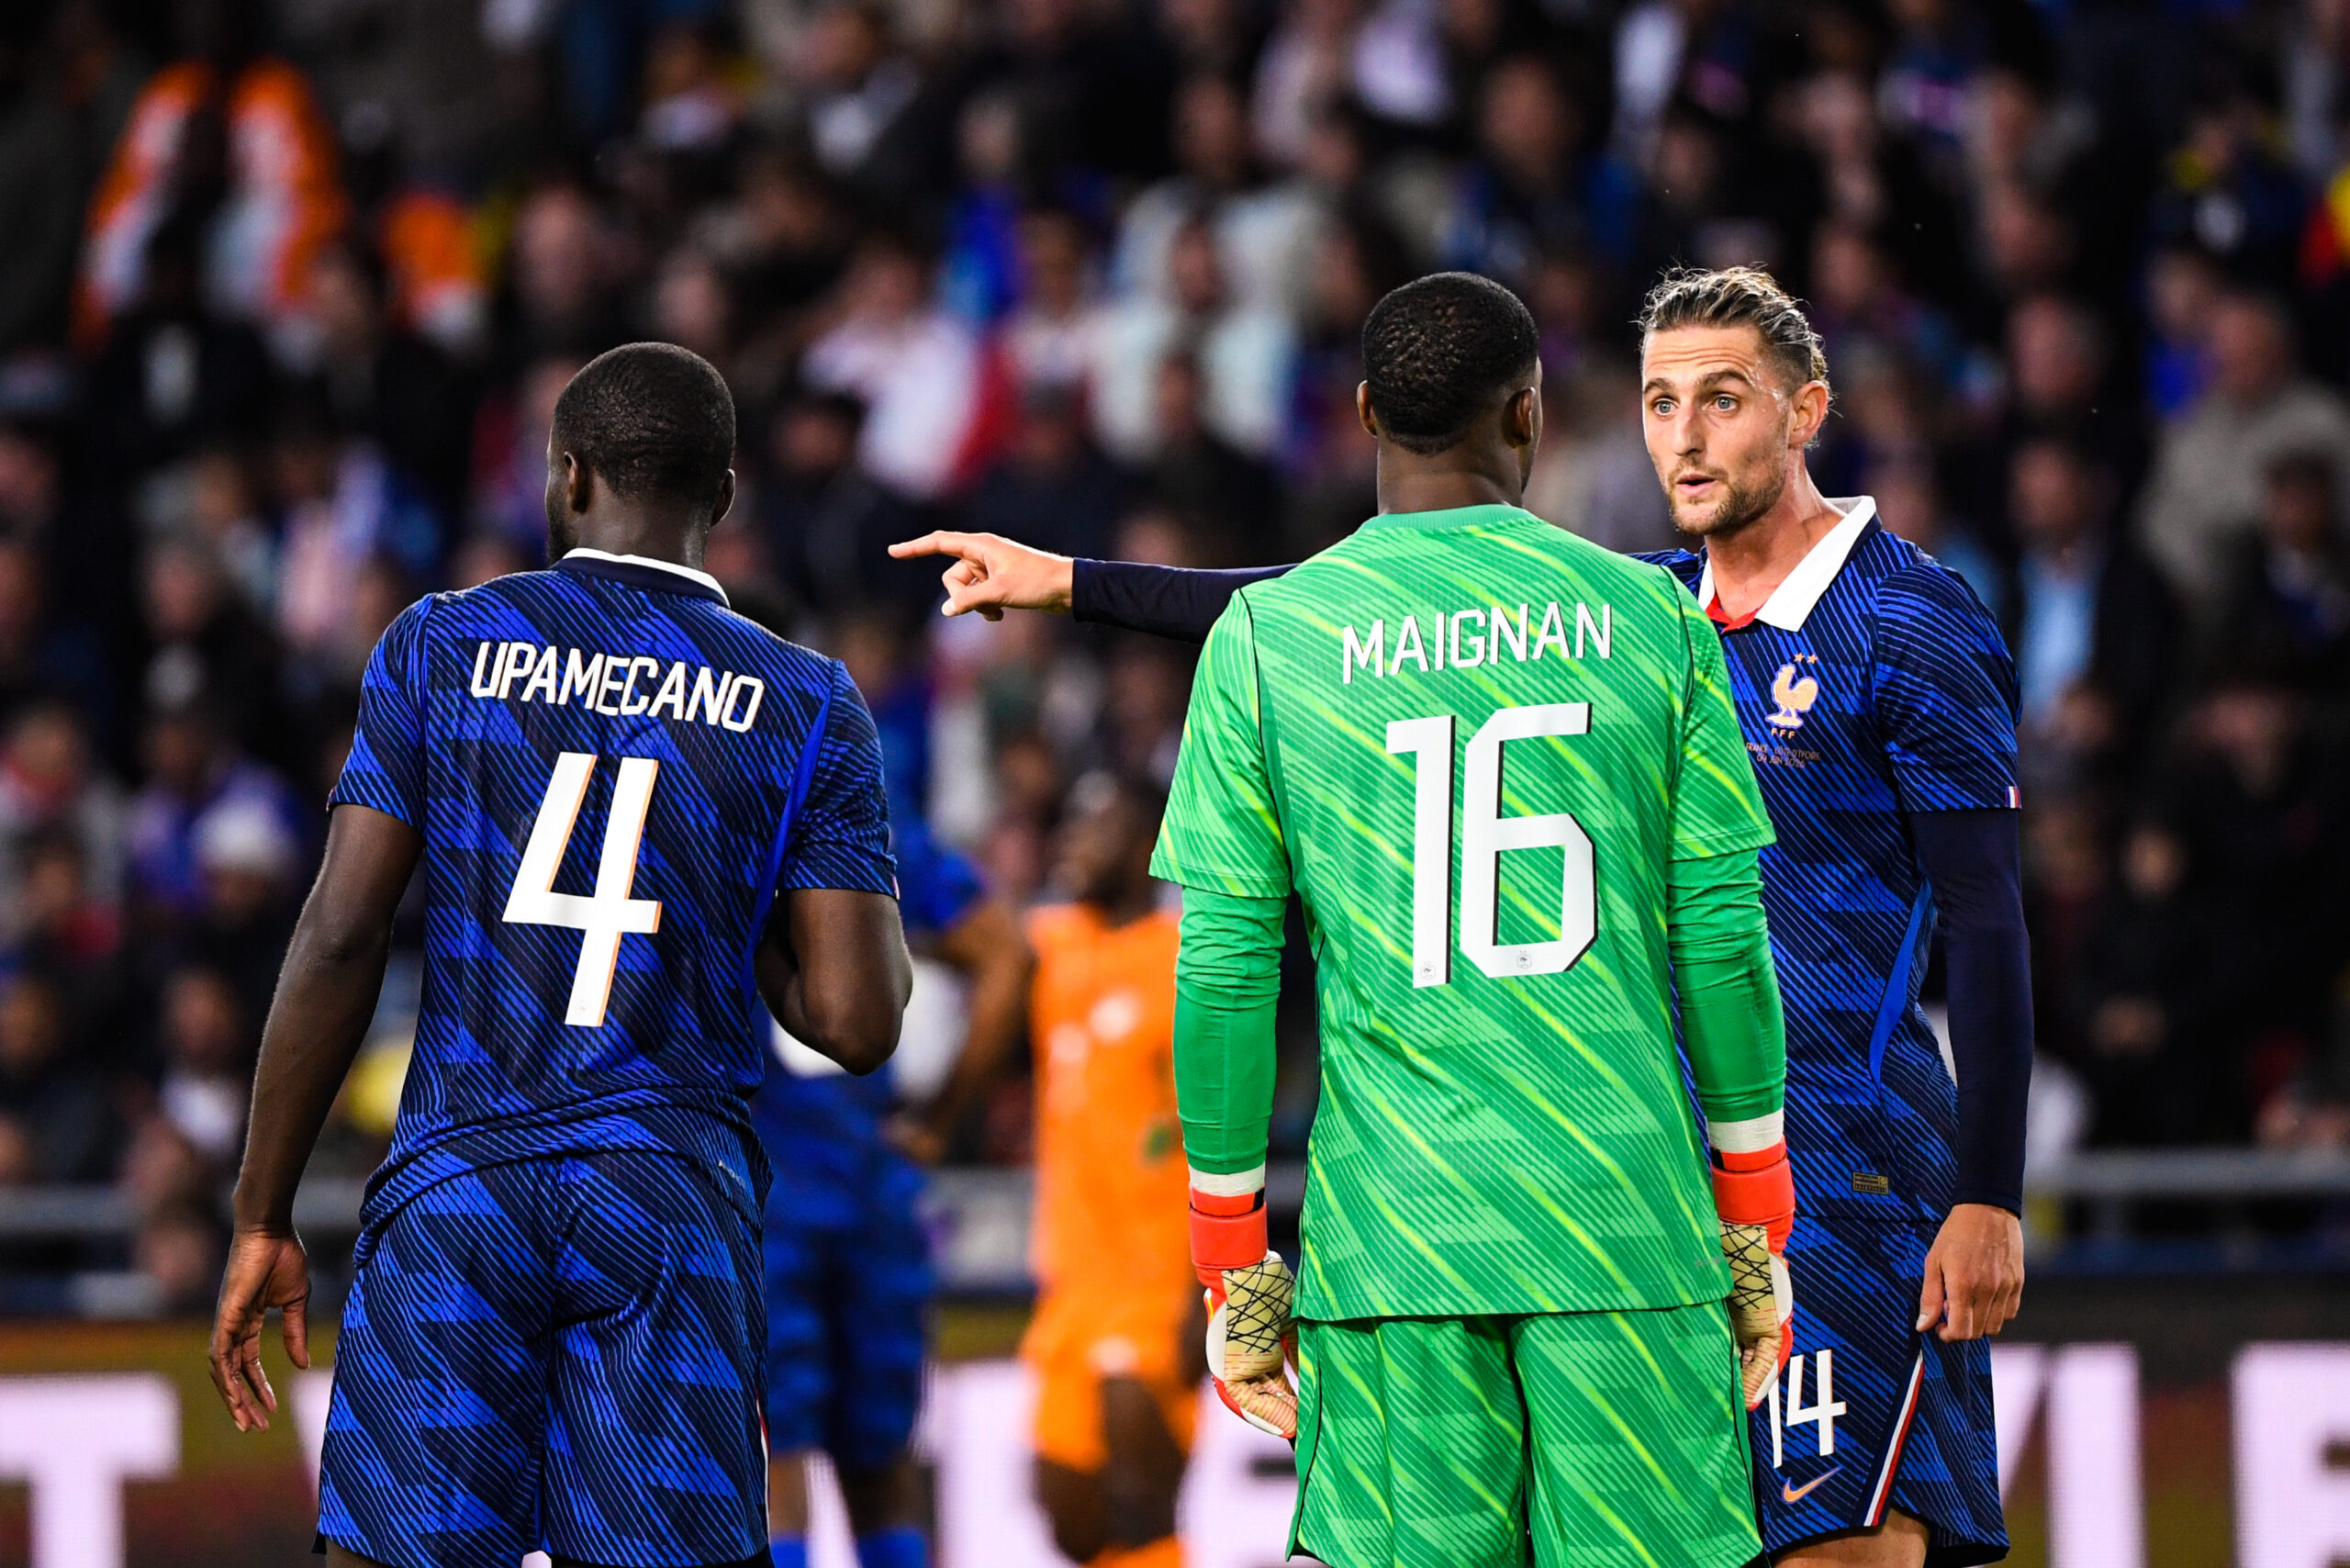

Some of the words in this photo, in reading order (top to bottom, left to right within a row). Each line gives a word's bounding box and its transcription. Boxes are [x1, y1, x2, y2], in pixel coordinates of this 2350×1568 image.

[471, 642, 765, 733] UPAMECANO
[1343, 602, 1612, 684] MAIGNAN
[502, 751, 662, 1027] 4
[1386, 702, 1599, 989] 16
[1768, 1349, 1846, 1469] 14
